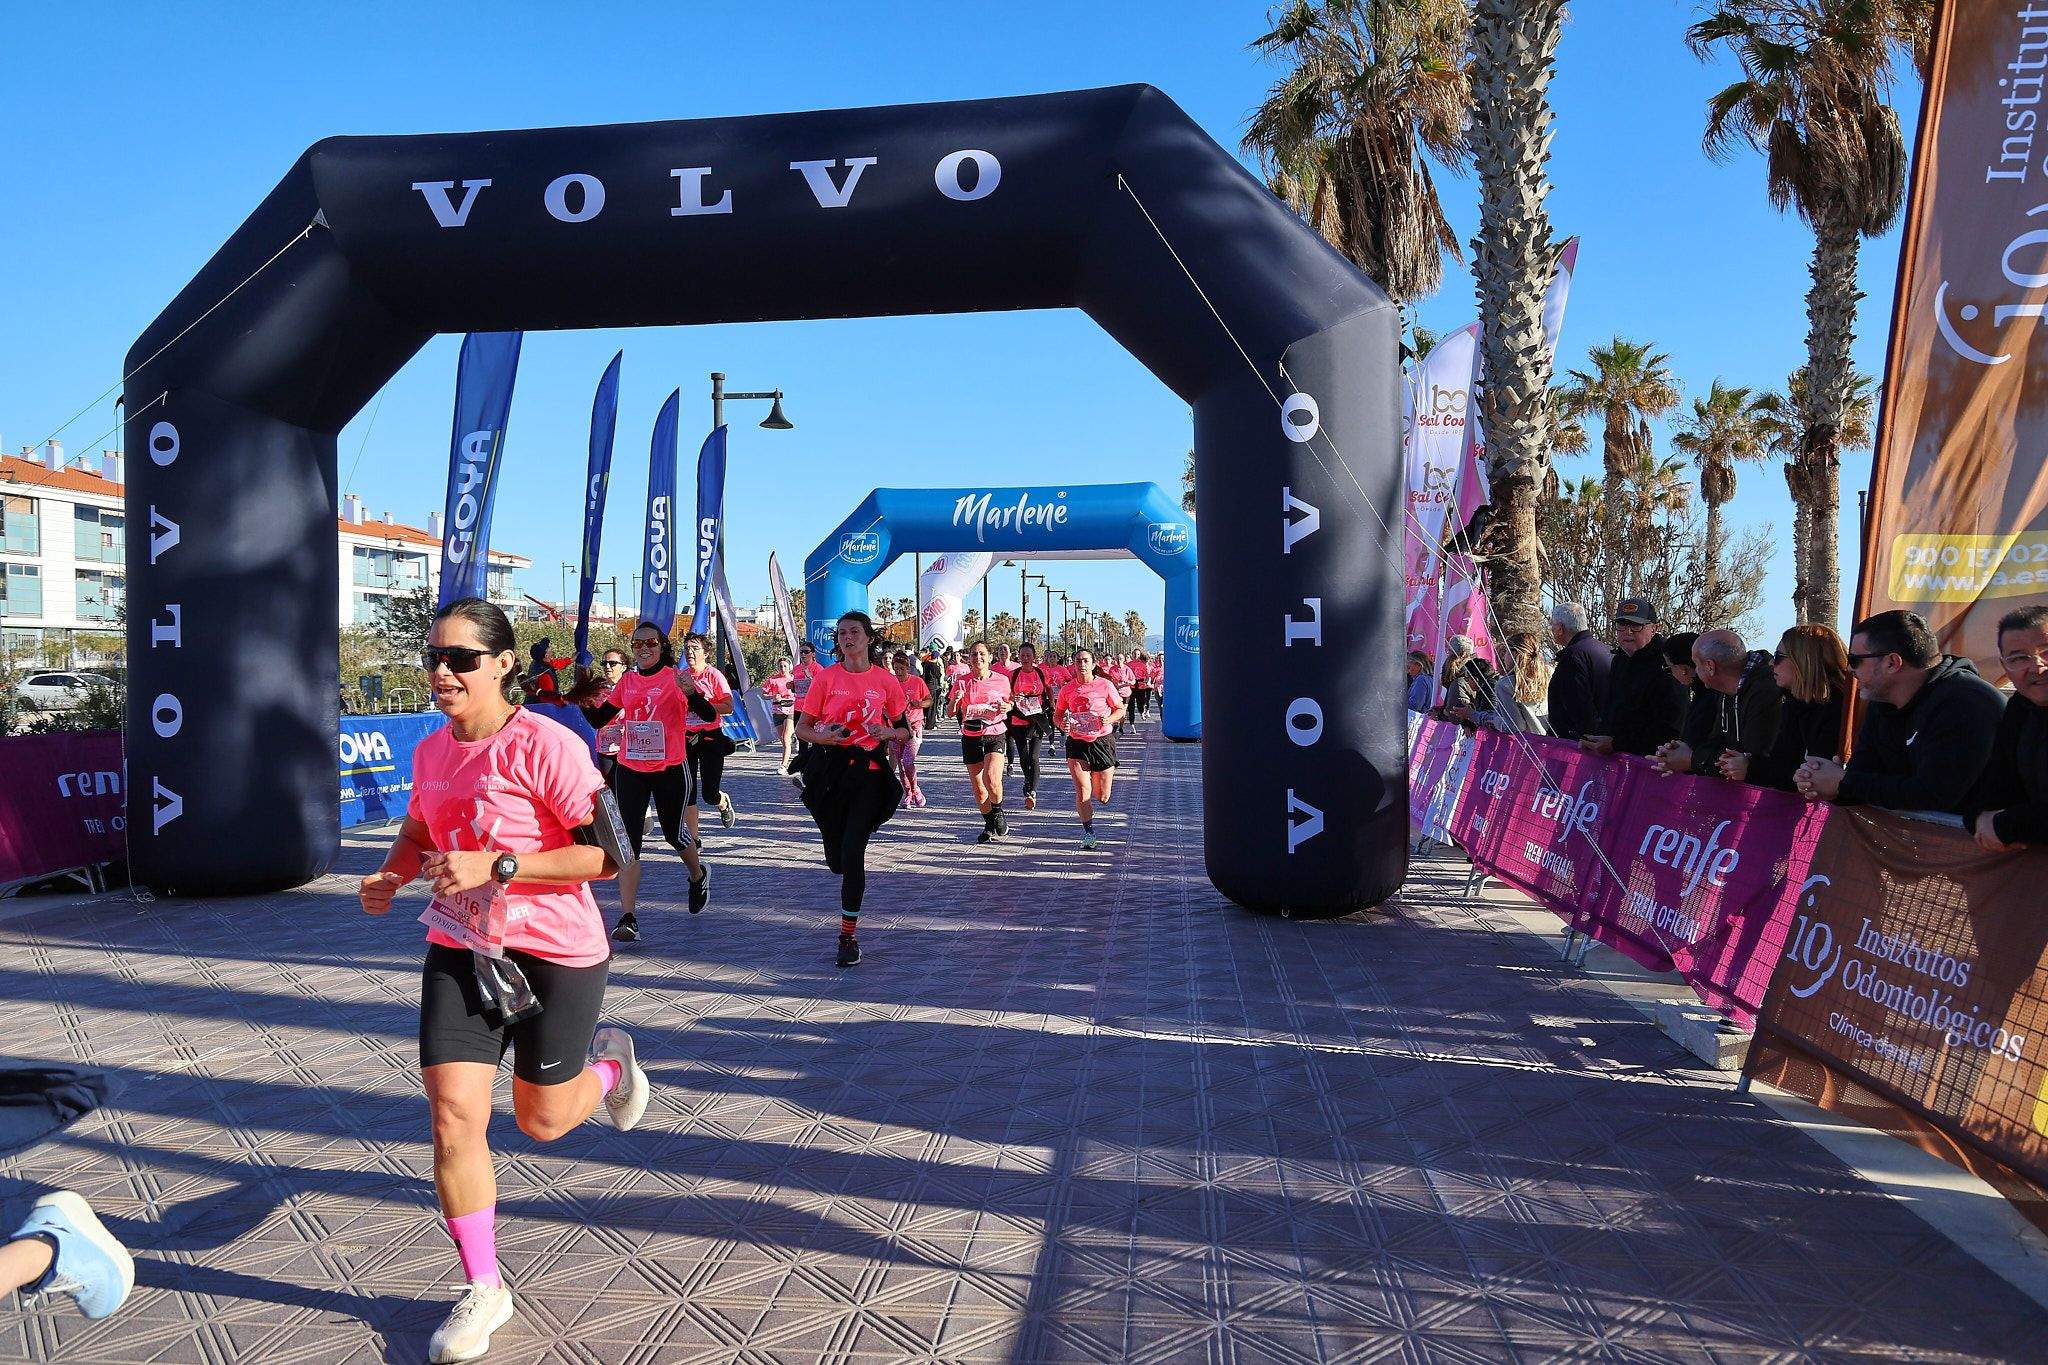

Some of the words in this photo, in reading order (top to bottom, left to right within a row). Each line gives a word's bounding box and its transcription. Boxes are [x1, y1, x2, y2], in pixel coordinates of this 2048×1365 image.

[1986, 3, 2048, 184] Institut
[412, 149, 1002, 228] VOLVO
[1443, 414, 1466, 427] Cos
[448, 430, 491, 564] GOYA
[953, 492, 1068, 543] Marlene
[649, 496, 667, 594] GOYA
[842, 540, 877, 555] Marlene
[1151, 529, 1188, 546] Marlene
[1905, 545, 1960, 567] 900
[149, 421, 183, 836] VOLVO
[1281, 392, 1324, 854] VOLVO
[340, 731, 391, 764] OYA
[401, 776, 414, 791] bue
[422, 780, 450, 791] OYSHO
[1531, 780, 1598, 843] renfe
[1638, 820, 1740, 898] renfe
[431, 914, 457, 932] OYSHO
[509, 905, 530, 921] JER
[1628, 892, 1658, 923] TREN
[1657, 905, 1700, 945] OFICIAL
[1854, 918, 1971, 988] Institutos
[1829, 1012, 1874, 1049] clínica
[1842, 959, 2025, 1062] Odontológicos
